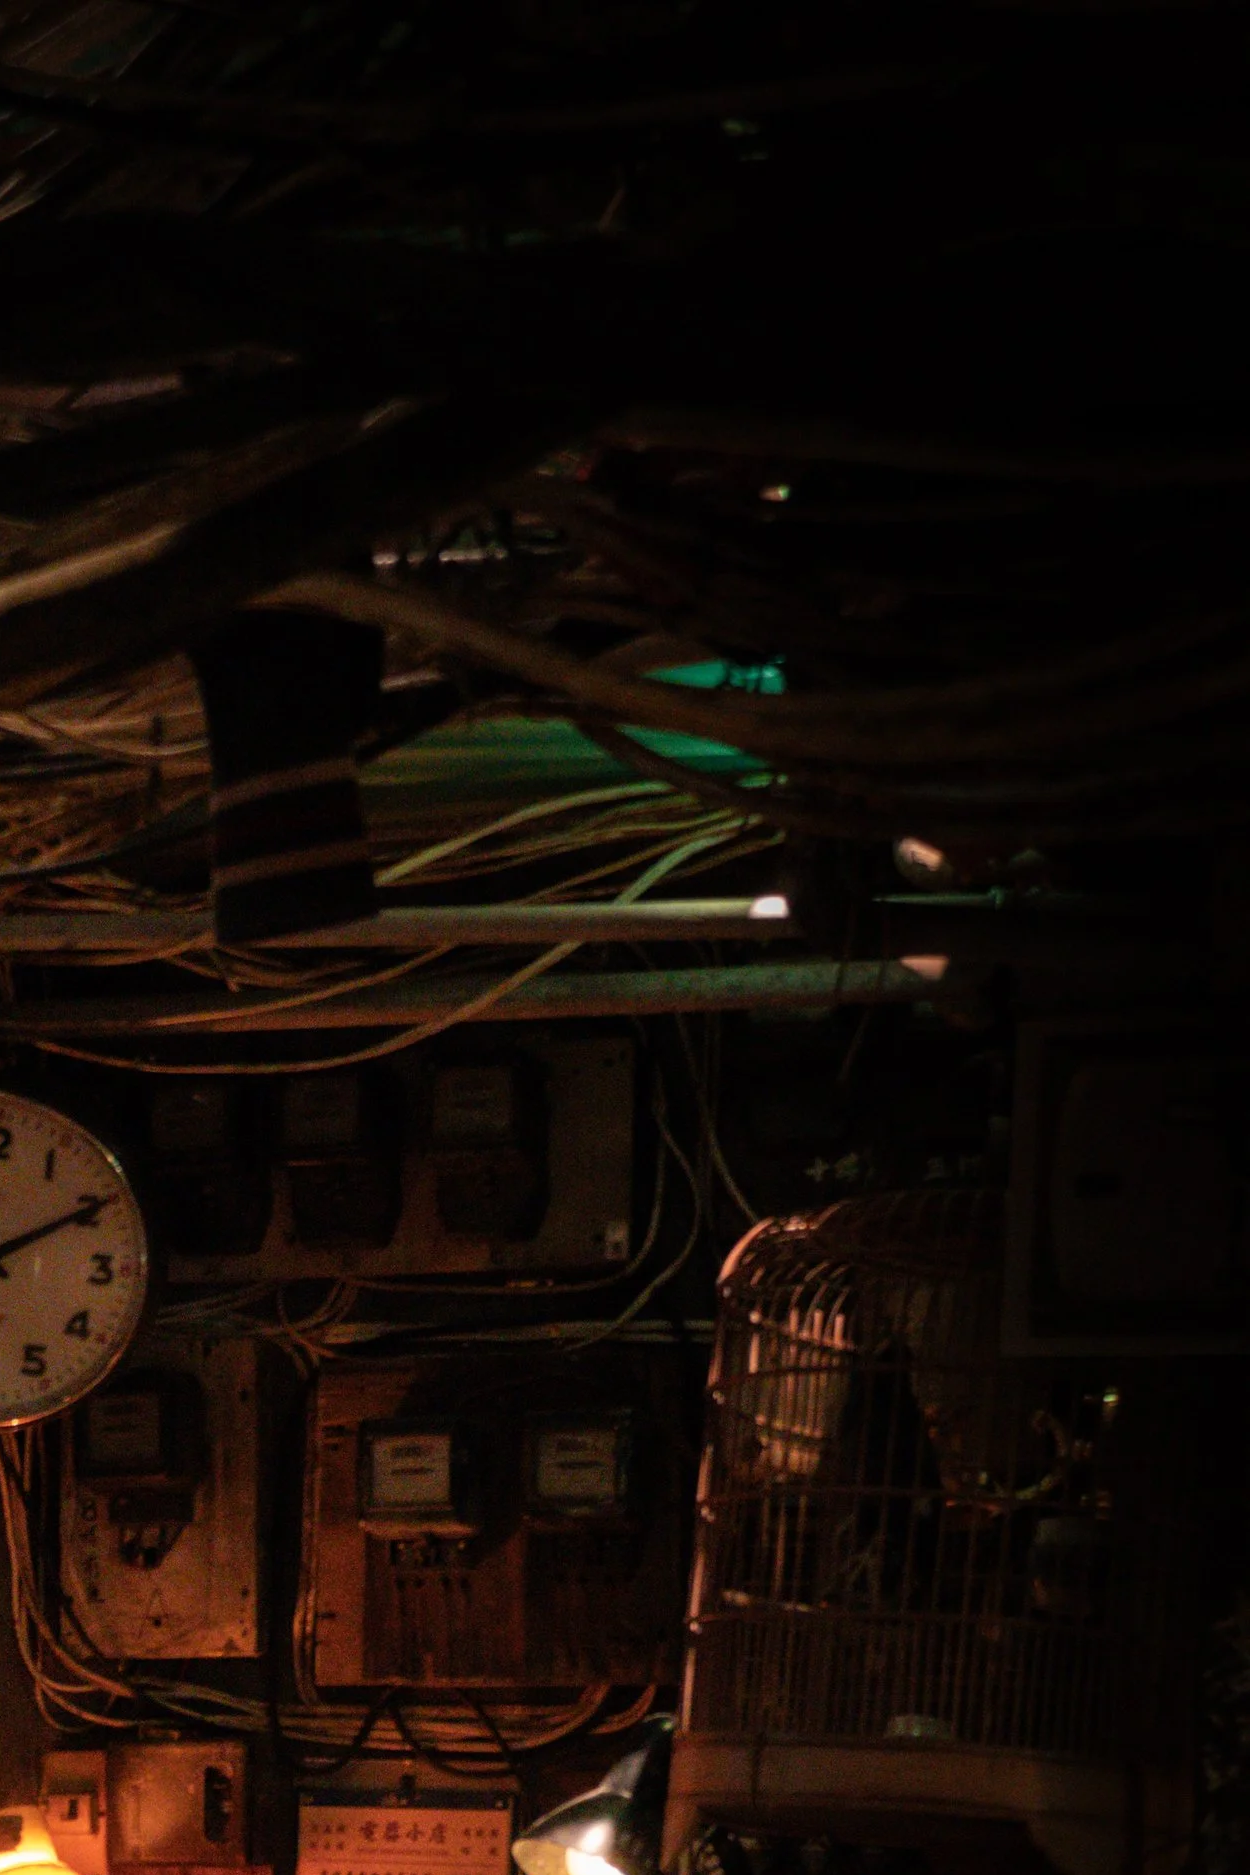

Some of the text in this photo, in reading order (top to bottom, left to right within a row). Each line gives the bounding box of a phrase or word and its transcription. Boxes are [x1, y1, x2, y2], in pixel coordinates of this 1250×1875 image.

[44, 1148, 56, 1182] 1
[87, 1254, 114, 1286] 3
[64, 1309, 91, 1340] 4
[21, 1344, 47, 1377] 5
